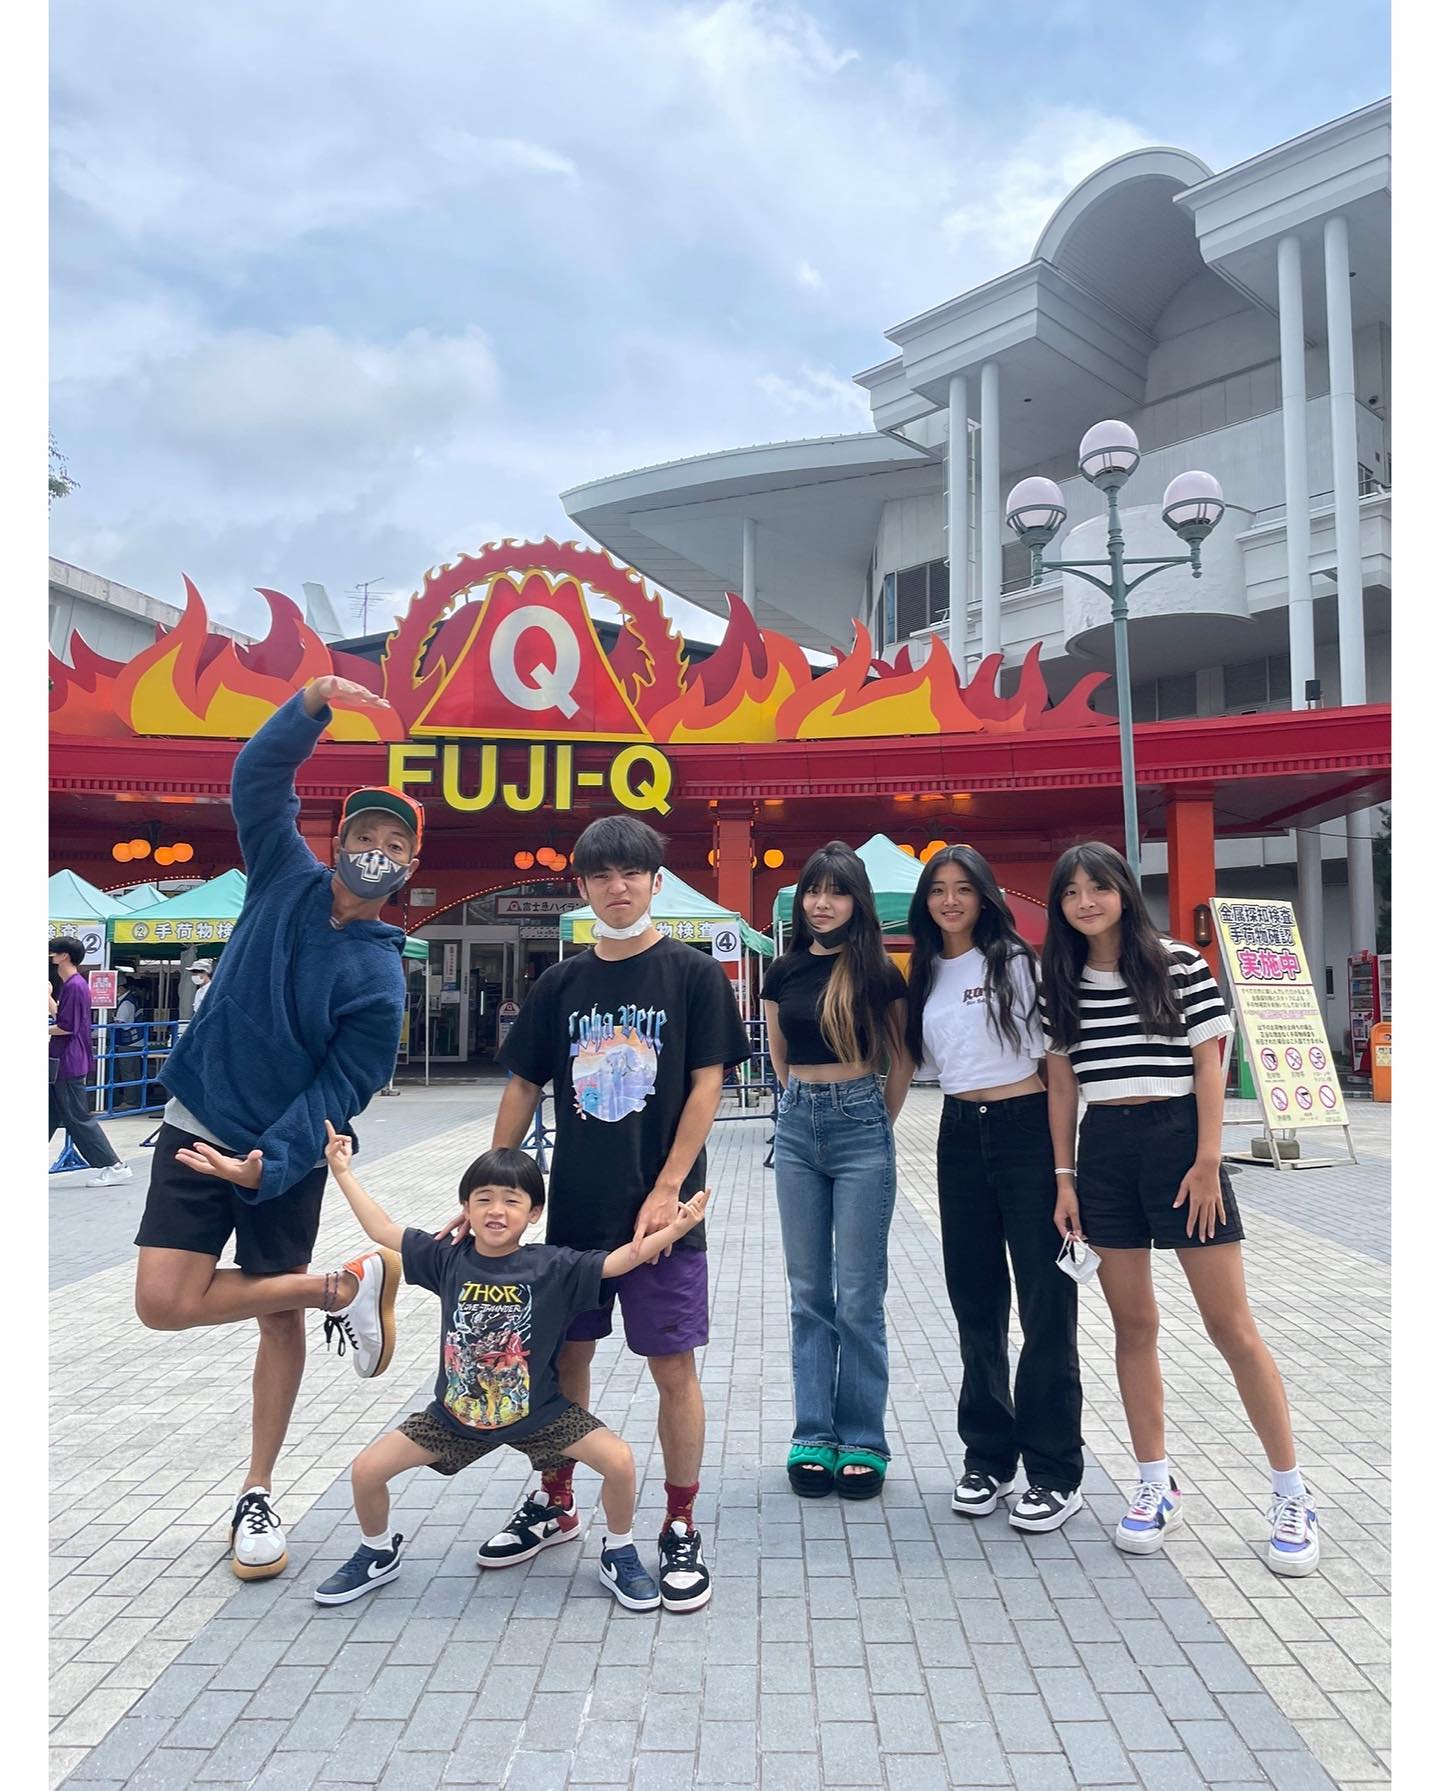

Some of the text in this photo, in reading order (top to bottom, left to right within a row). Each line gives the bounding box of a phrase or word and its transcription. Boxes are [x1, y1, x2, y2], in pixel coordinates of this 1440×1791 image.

[489, 605, 580, 719] Q
[389, 744, 672, 816] FUJI-Q
[1219, 904, 1294, 925] 金属探知検査
[1230, 926, 1294, 945] 手荷物確認
[1237, 948, 1300, 980] 実施中
[460, 1282, 523, 1303] THOR
